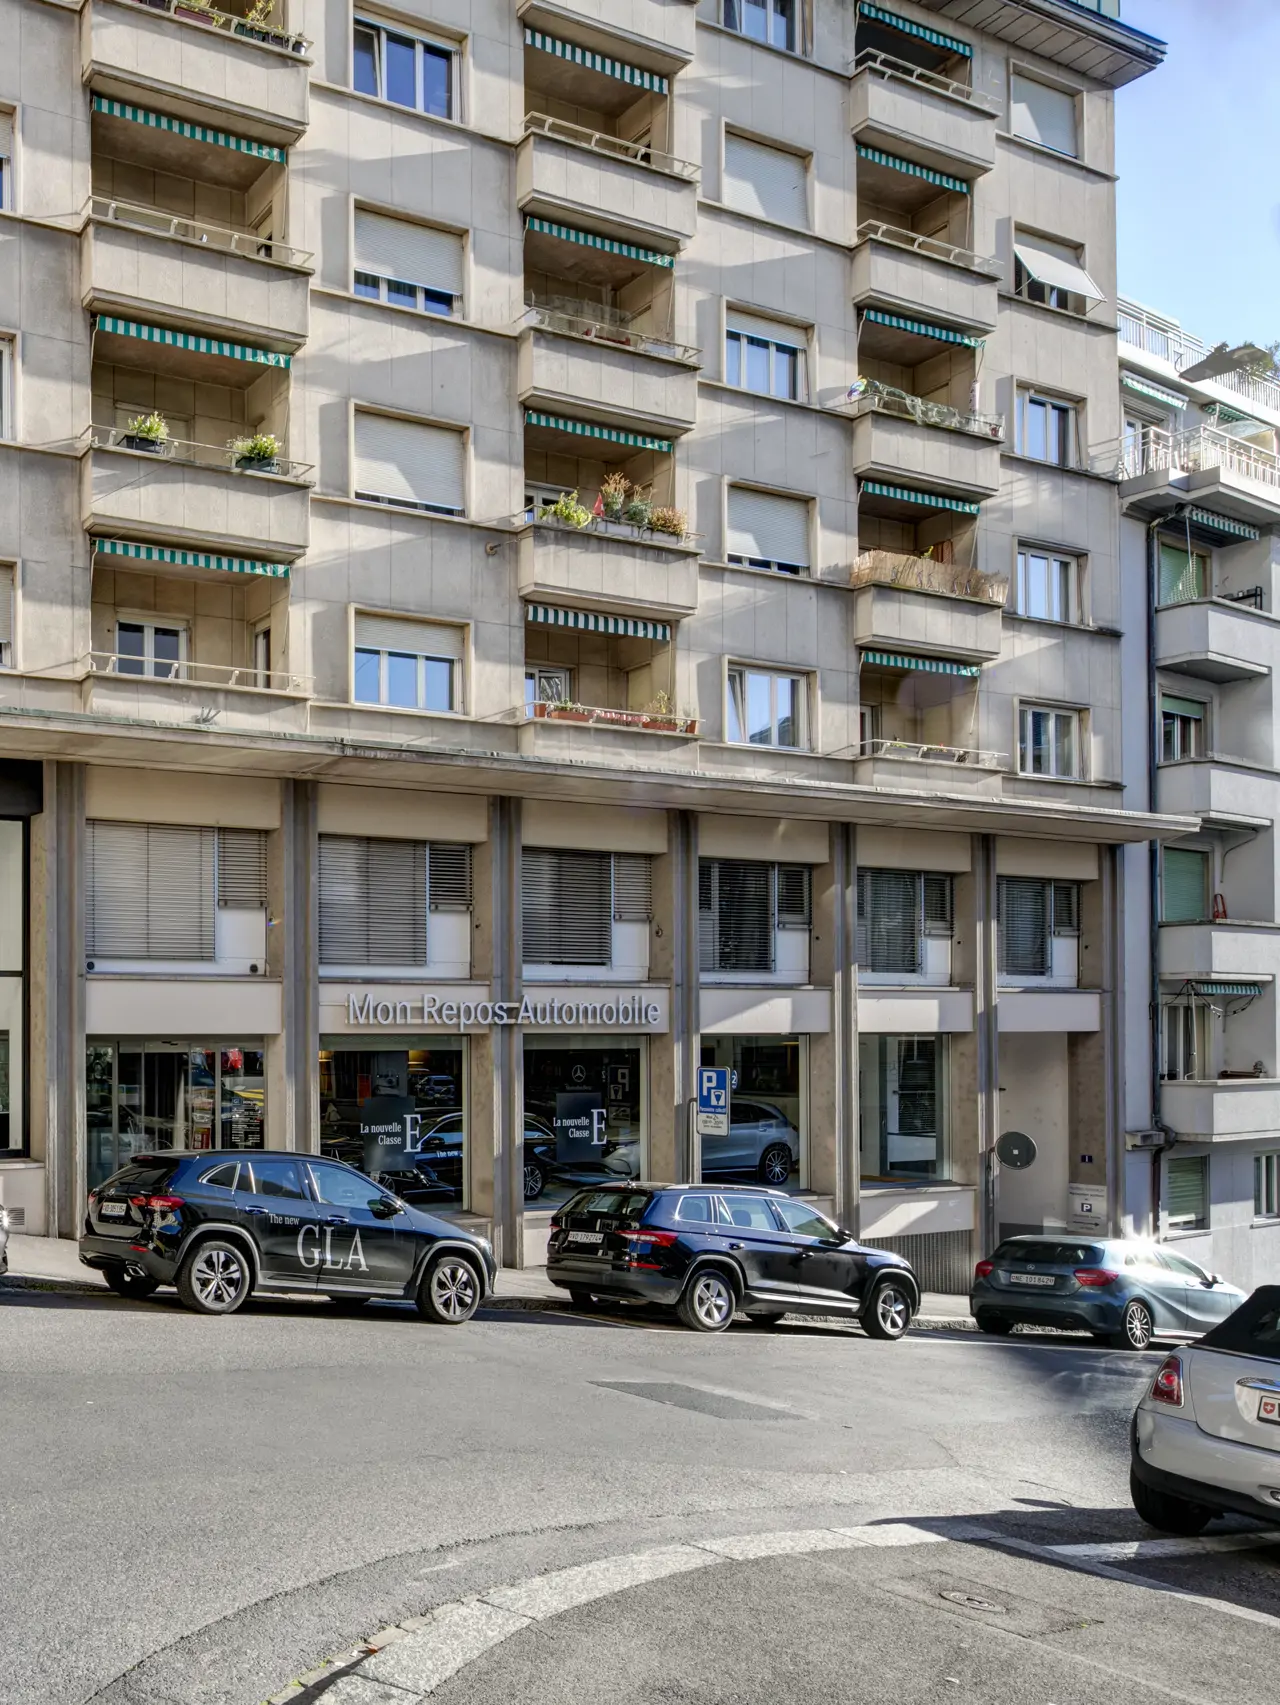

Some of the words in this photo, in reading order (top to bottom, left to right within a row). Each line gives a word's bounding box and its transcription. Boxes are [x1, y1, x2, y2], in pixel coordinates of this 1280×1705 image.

[348, 994, 411, 1024] Mon
[423, 993, 507, 1032] Repos
[518, 994, 661, 1025] Automobile
[702, 1071, 717, 1096] P
[360, 1123, 369, 1133] La
[371, 1122, 402, 1133] nouvelle
[553, 1117, 561, 1127] La
[562, 1116, 590, 1127] nouvelle
[590, 1108, 608, 1145] E
[378, 1135, 402, 1145] Classe
[403, 1114, 422, 1153] E
[568, 1128, 590, 1138] Classe
[269, 1213, 283, 1224] The
[284, 1216, 300, 1225] new
[297, 1224, 370, 1272] GLA
